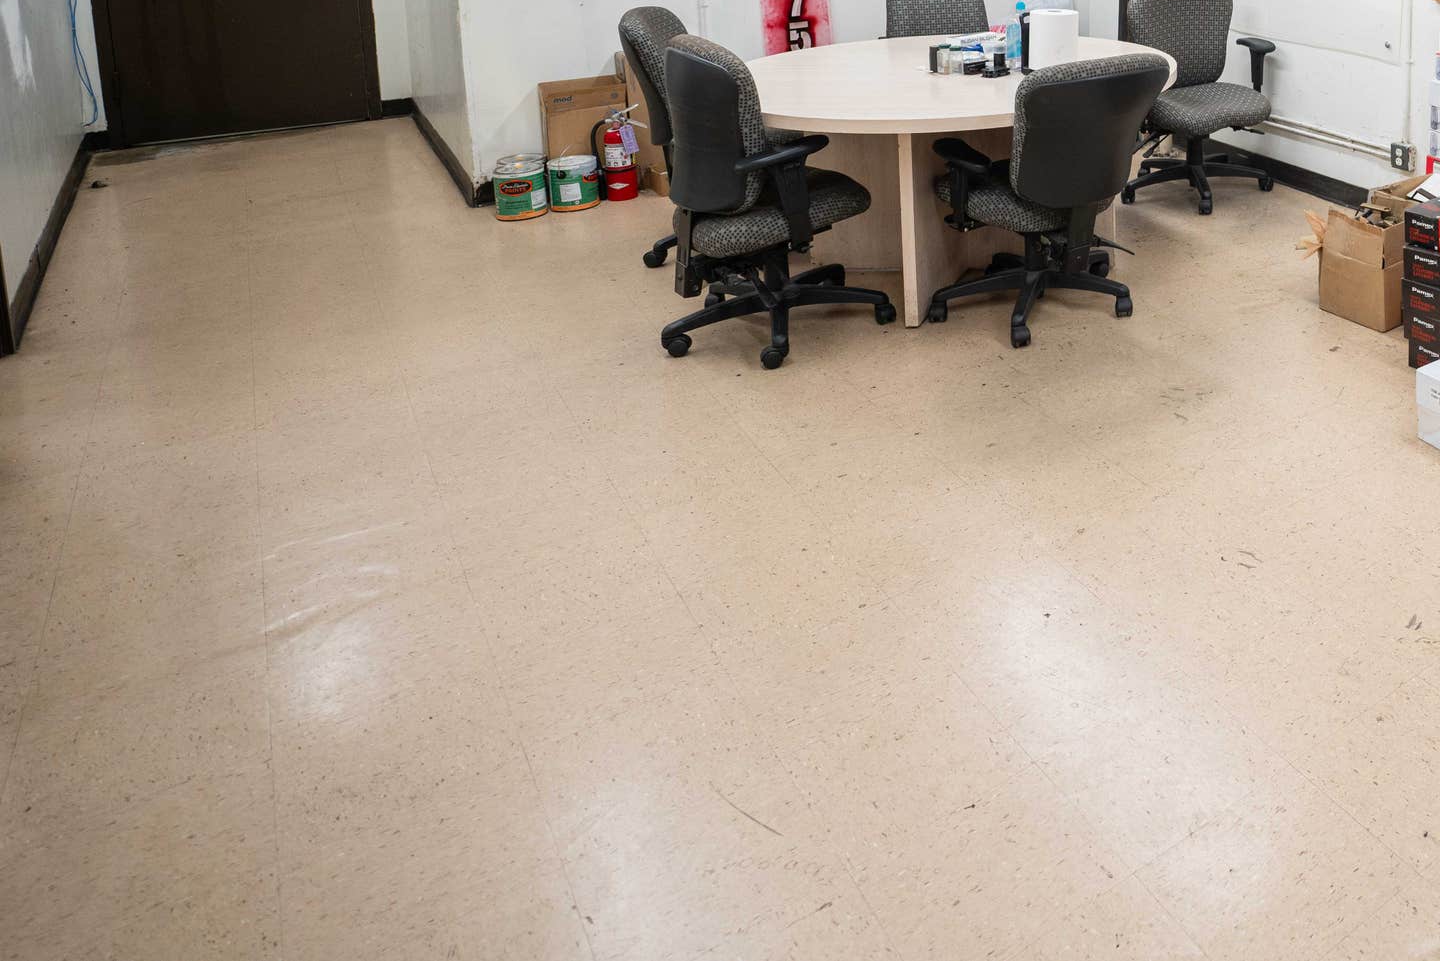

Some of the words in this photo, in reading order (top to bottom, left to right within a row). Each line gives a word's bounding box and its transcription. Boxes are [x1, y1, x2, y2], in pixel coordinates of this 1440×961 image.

[553, 95, 573, 104] mod
[1412, 219, 1434, 230] Pamex
[1414, 254, 1438, 266] Pamex
[1411, 287, 1434, 298] Pamex
[1413, 317, 1434, 329] Pamex
[1418, 345, 1440, 357] Pamex
